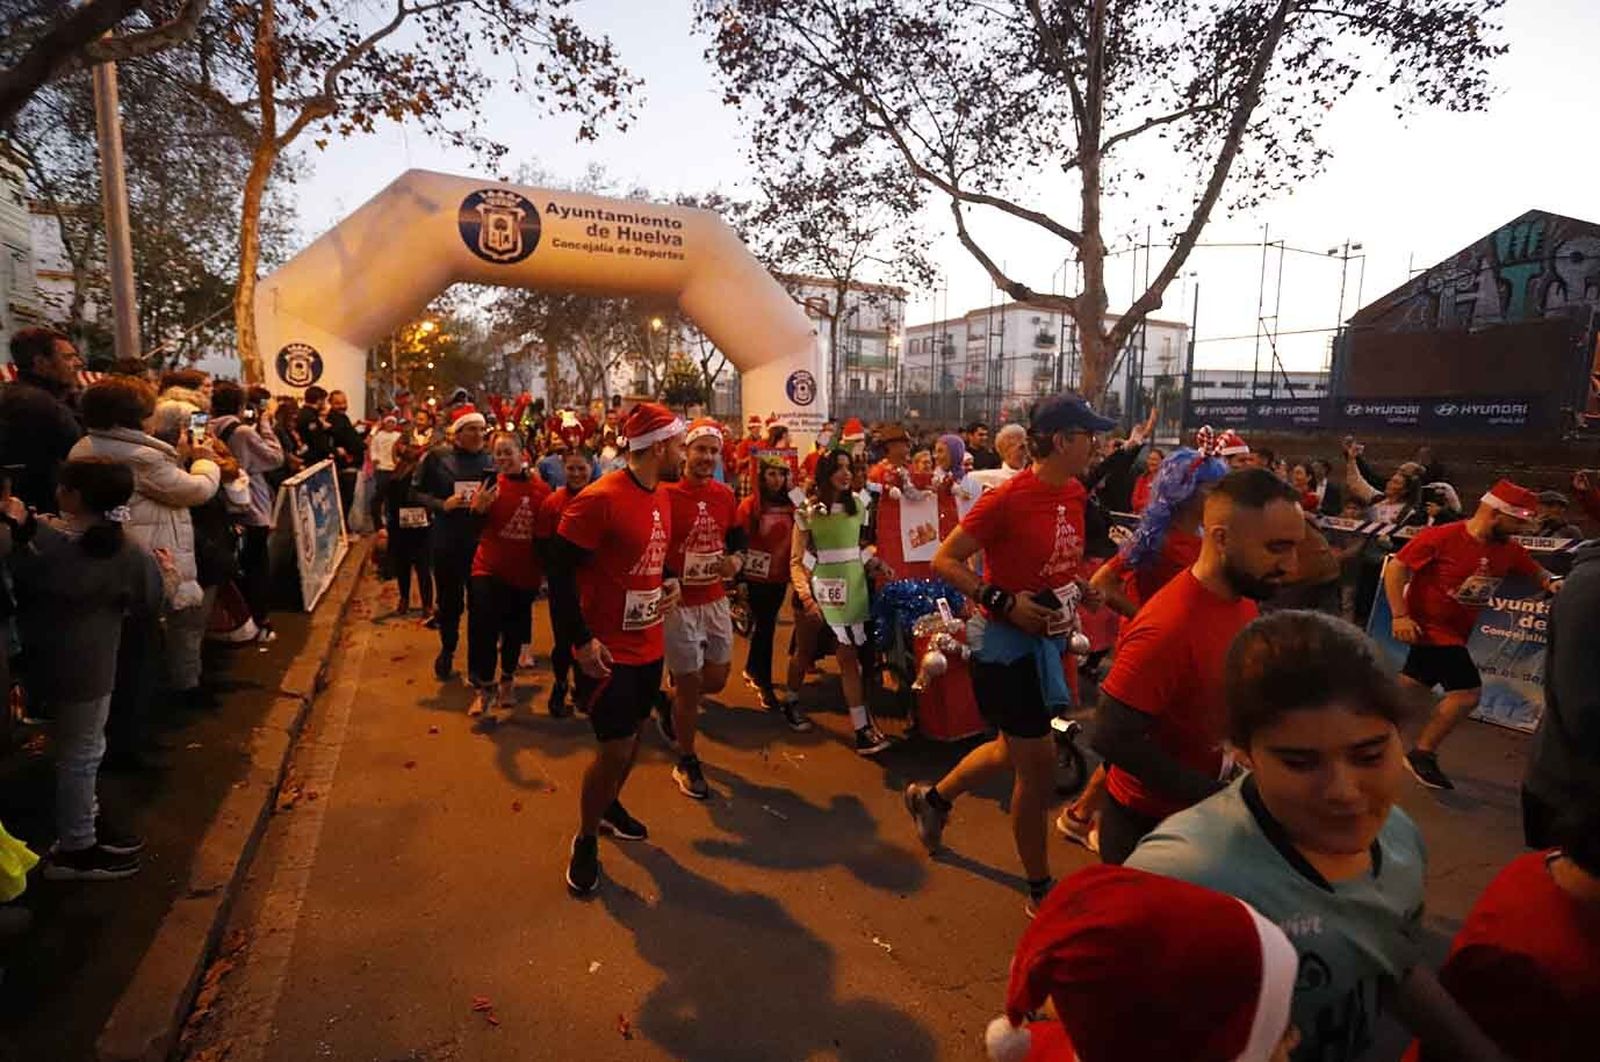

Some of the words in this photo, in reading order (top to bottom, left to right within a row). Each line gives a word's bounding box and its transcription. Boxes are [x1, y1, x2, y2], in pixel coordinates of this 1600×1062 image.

[545, 202, 682, 229] Ayuntamiento
[586, 222, 610, 239] de
[617, 225, 683, 247] Huelva
[617, 245, 631, 254] de
[634, 246, 685, 261] Deportes
[1274, 404, 1320, 415] HYUNDAI
[1364, 404, 1421, 416] HYUNDAI
[1460, 403, 1529, 416] HYUNDAI
[828, 588, 841, 600] 66
[1518, 615, 1547, 630] de
